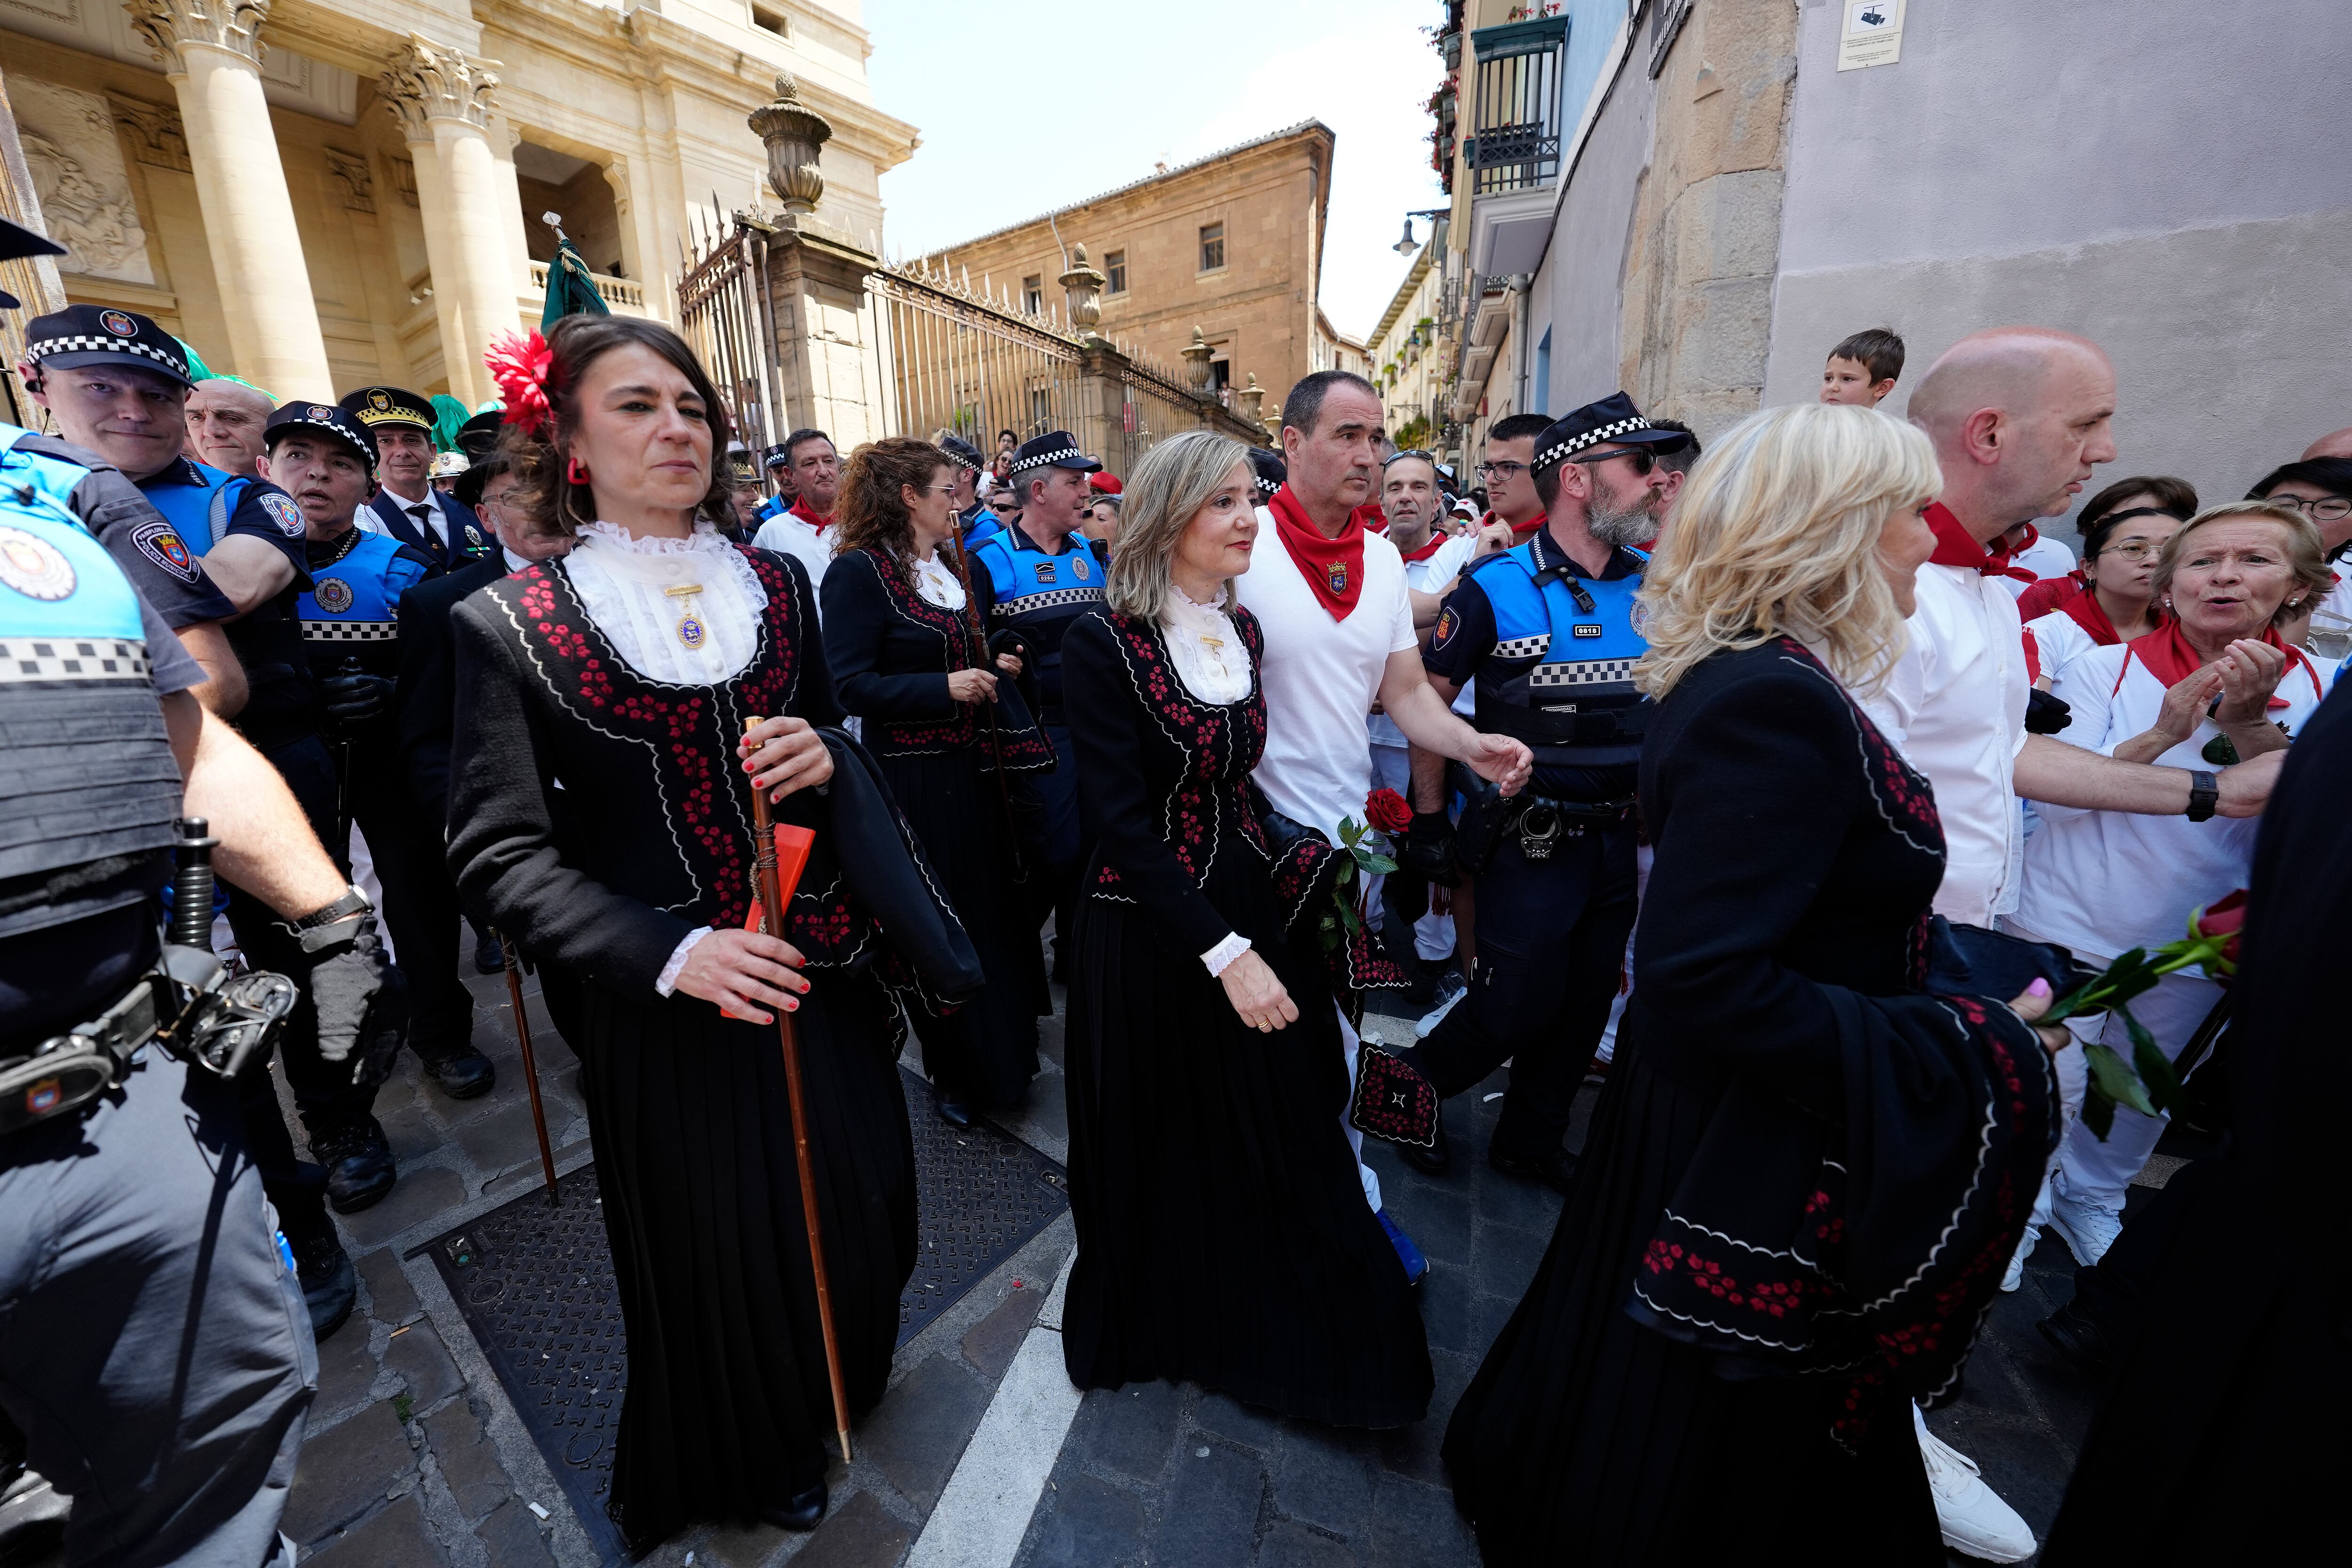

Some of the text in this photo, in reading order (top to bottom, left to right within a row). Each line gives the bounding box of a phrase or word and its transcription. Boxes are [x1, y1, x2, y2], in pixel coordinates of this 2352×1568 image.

[273, 511, 290, 532] MUNICIPAL
[137, 526, 165, 541] PAMPLONA
[140, 541, 161, 562] POLICIA
[160, 559, 191, 580] MUNICIPAL
